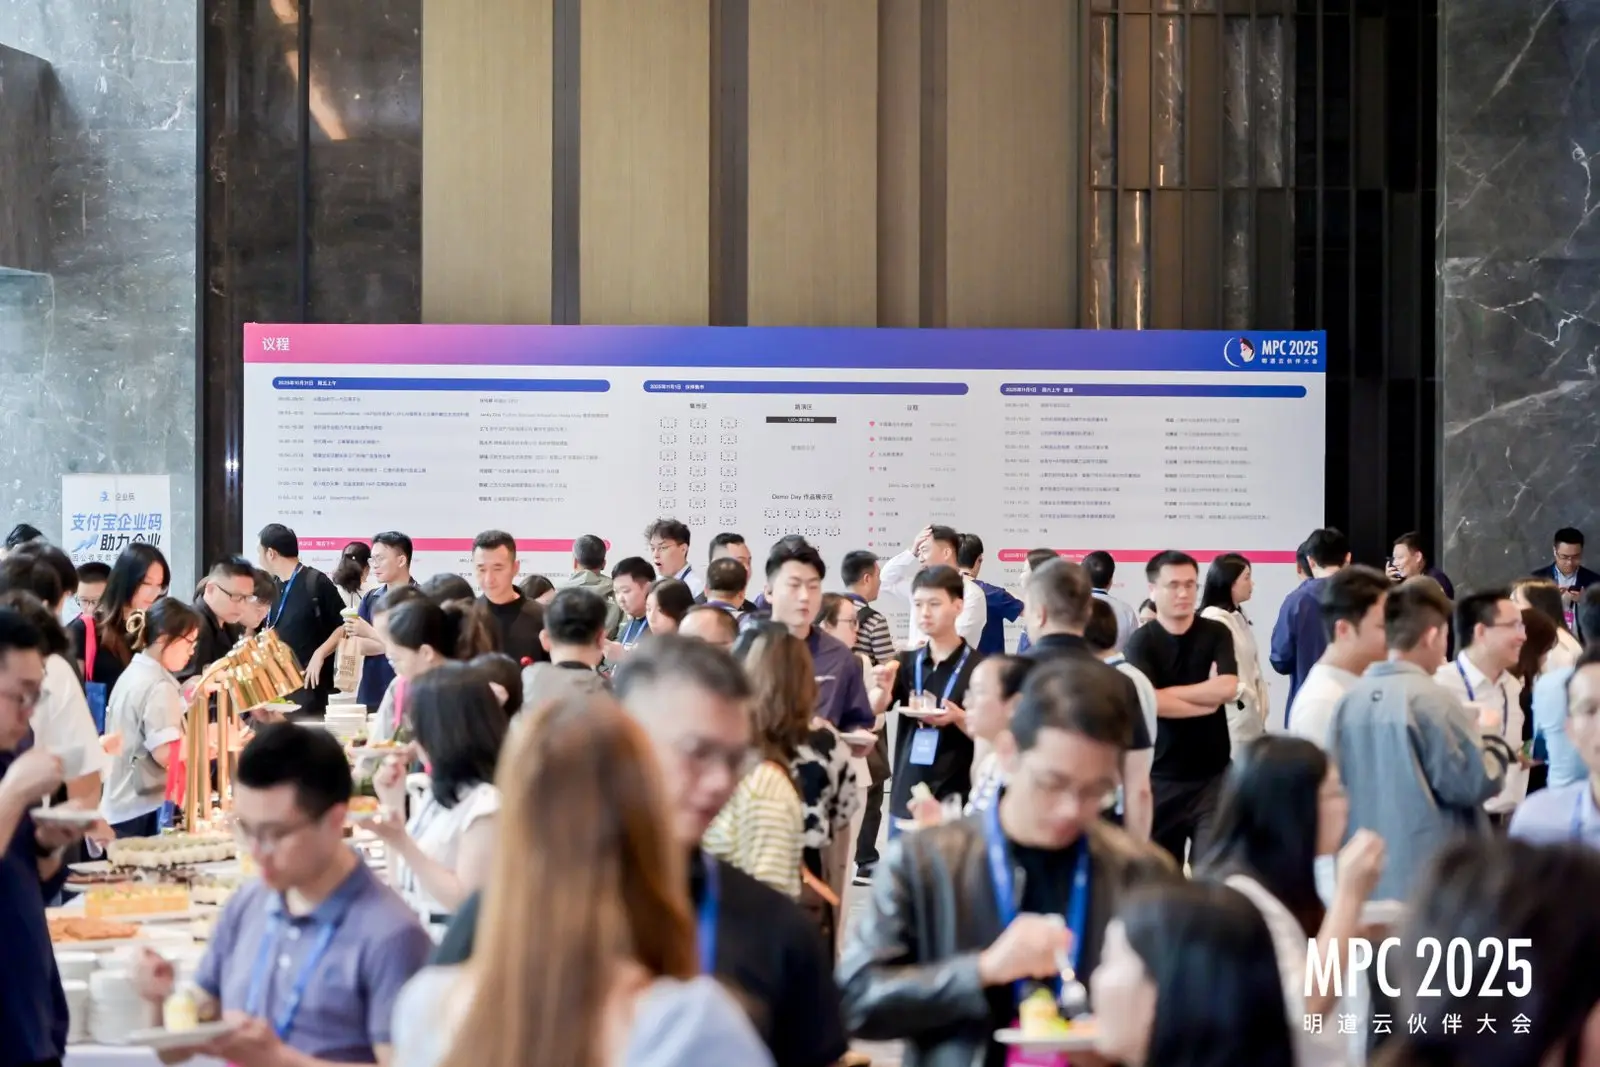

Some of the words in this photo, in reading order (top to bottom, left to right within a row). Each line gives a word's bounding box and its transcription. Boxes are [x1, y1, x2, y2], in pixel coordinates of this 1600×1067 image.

[262, 336, 290, 351] 议程
[1262, 340, 1286, 355] MPC
[1289, 341, 1318, 356] 2025
[70, 513, 162, 531] 支付宝企业码
